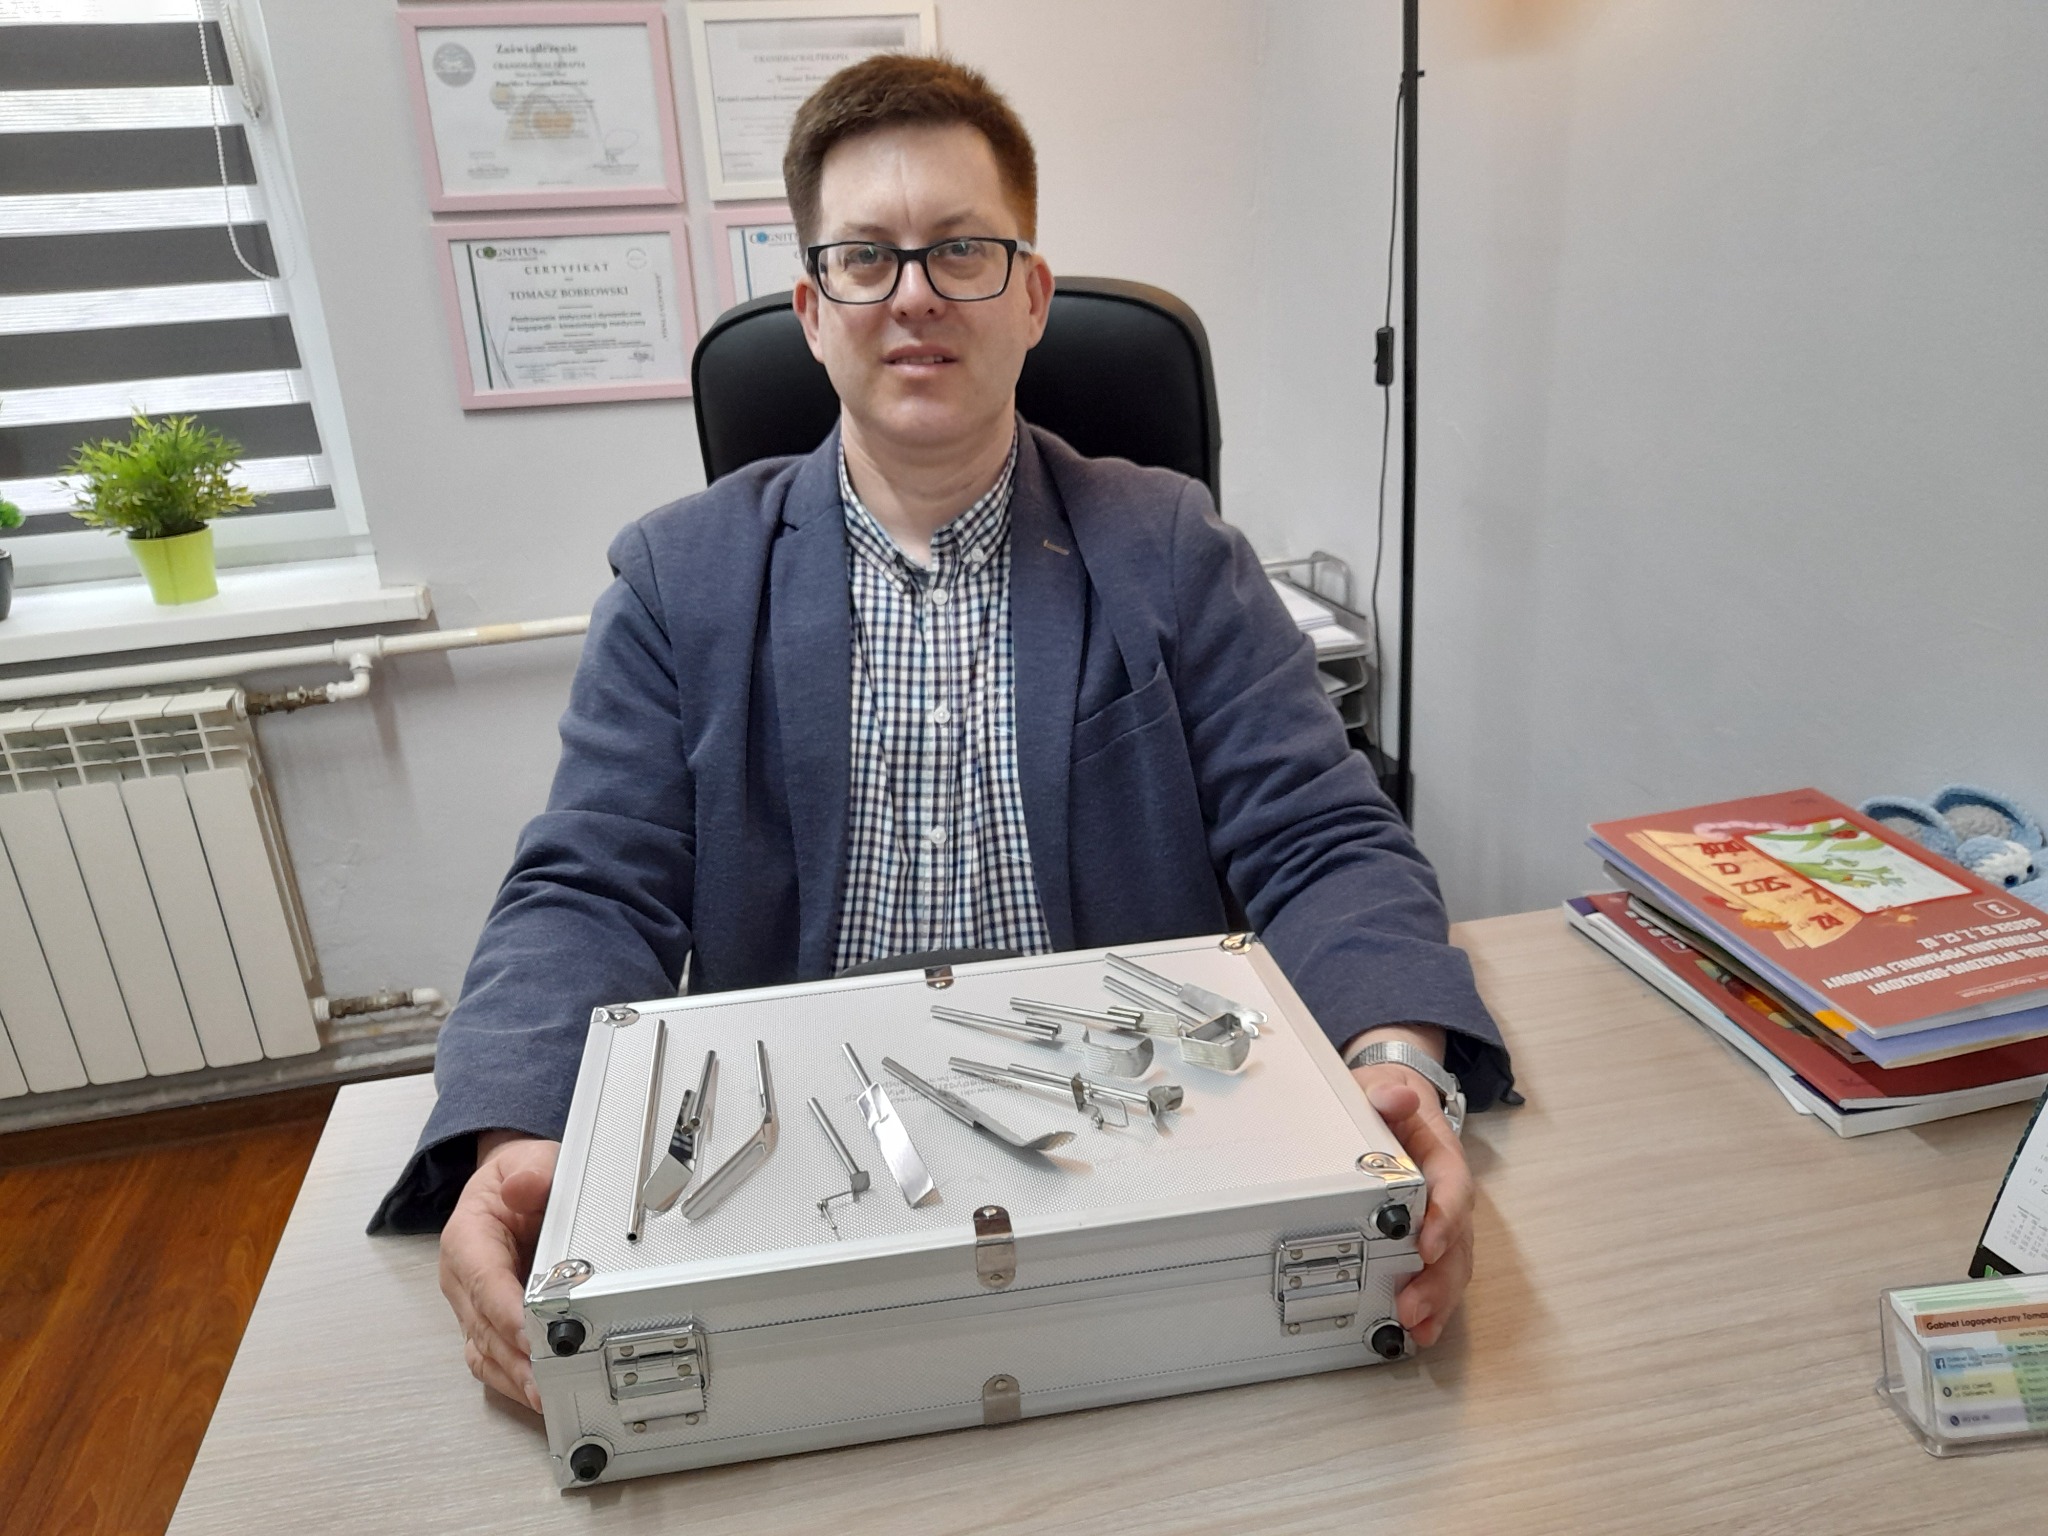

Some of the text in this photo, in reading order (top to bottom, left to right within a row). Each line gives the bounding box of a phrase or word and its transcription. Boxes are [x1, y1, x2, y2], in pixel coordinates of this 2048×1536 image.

[524, 263, 610, 276] CERTYFIKAT
[510, 285, 629, 301] TOMASZ BOBROWSKI
[1987, 903, 2007, 915] 3
[1991, 917, 2042, 933] GŁOSEK
[1961, 932, 2044, 955] UTRWALANIA
[1886, 946, 1968, 973] POPRAWNEJ
[1821, 965, 1893, 990] WYMOWY
[1866, 950, 2027, 996] WYRAZOWO-OBRAZKOWY
[1926, 1311, 2048, 1331] Gabinet Logopedyczny Tomas
